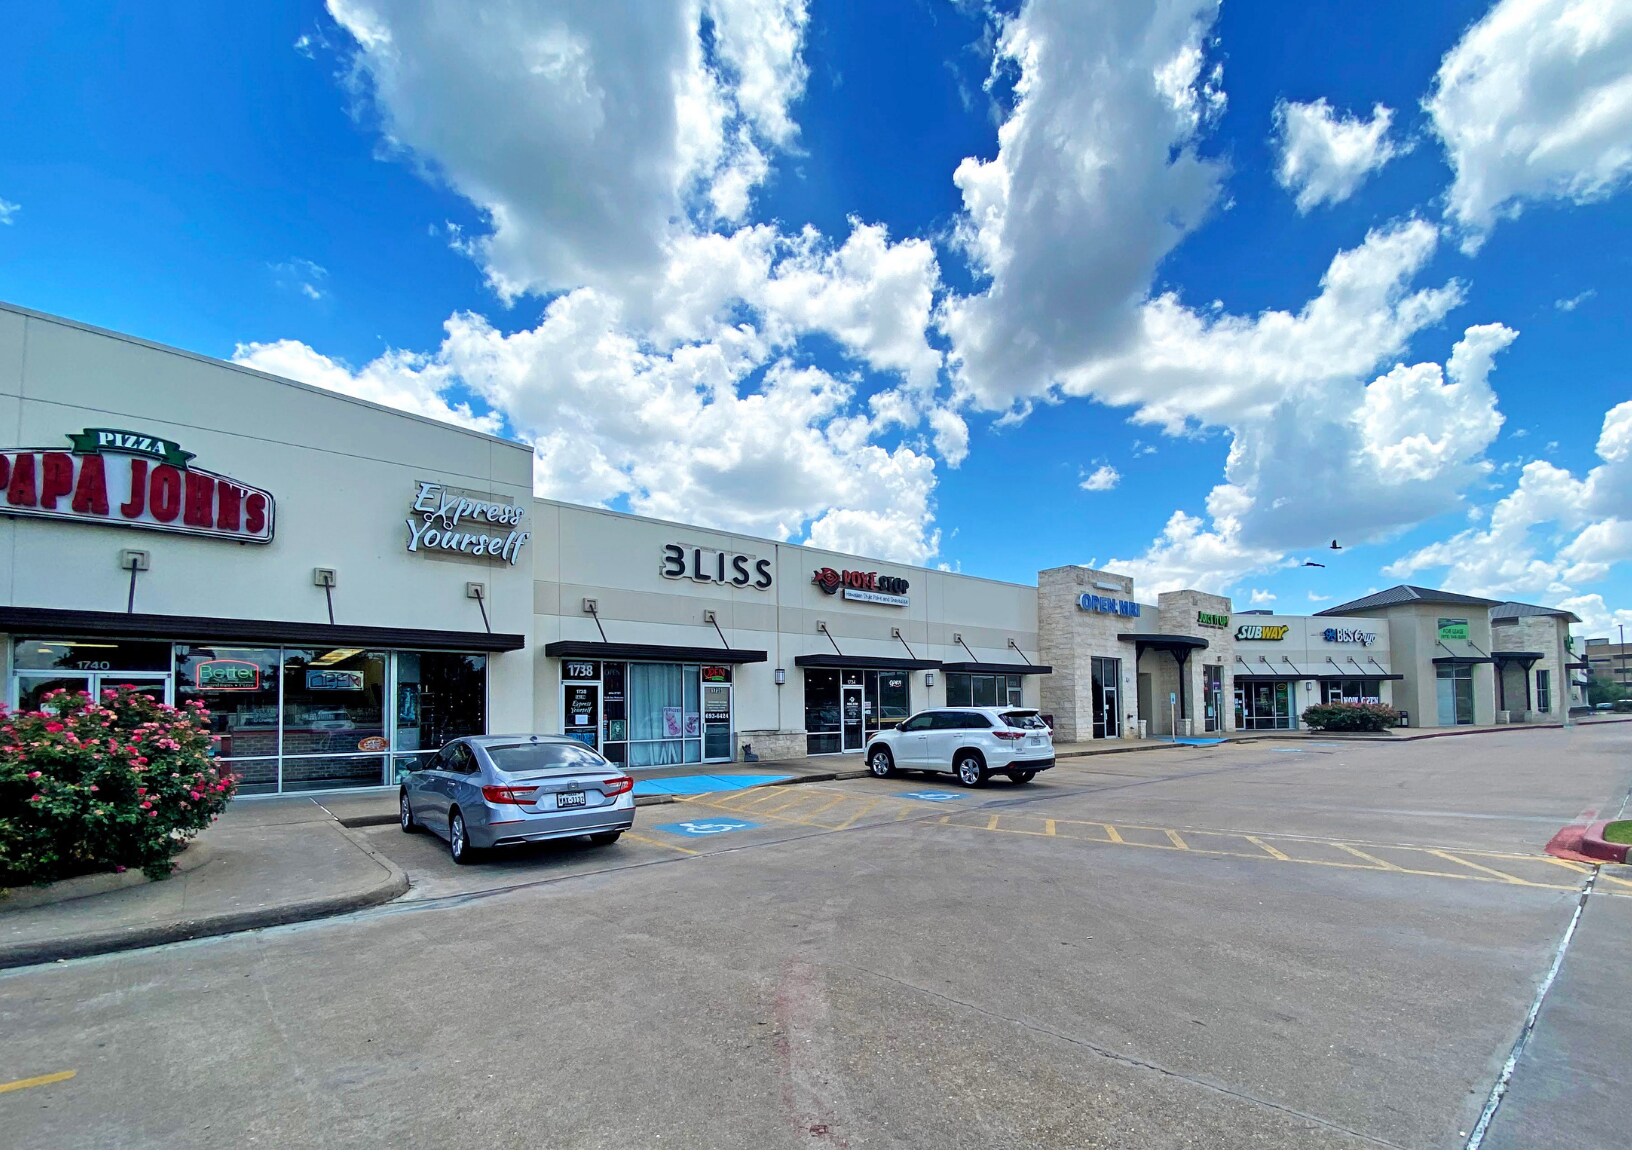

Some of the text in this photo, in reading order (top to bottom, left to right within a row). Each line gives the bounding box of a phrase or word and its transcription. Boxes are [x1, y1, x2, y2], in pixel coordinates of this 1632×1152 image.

[98, 431, 167, 455] PIZZA
[0, 451, 267, 534] APA JOHN'S
[412, 482, 525, 526] Express
[406, 518, 531, 566] Yourself
[878, 575, 910, 595] STOP
[1080, 593, 1141, 618] OPEN MRI
[1236, 625, 1288, 640] SUBWAY
[1335, 628, 1354, 642] BCS
[76, 660, 110, 671] 1740
[567, 664, 594, 677] 1738
[309, 672, 362, 688] OPEN
[1343, 696, 1359, 704] NOW
